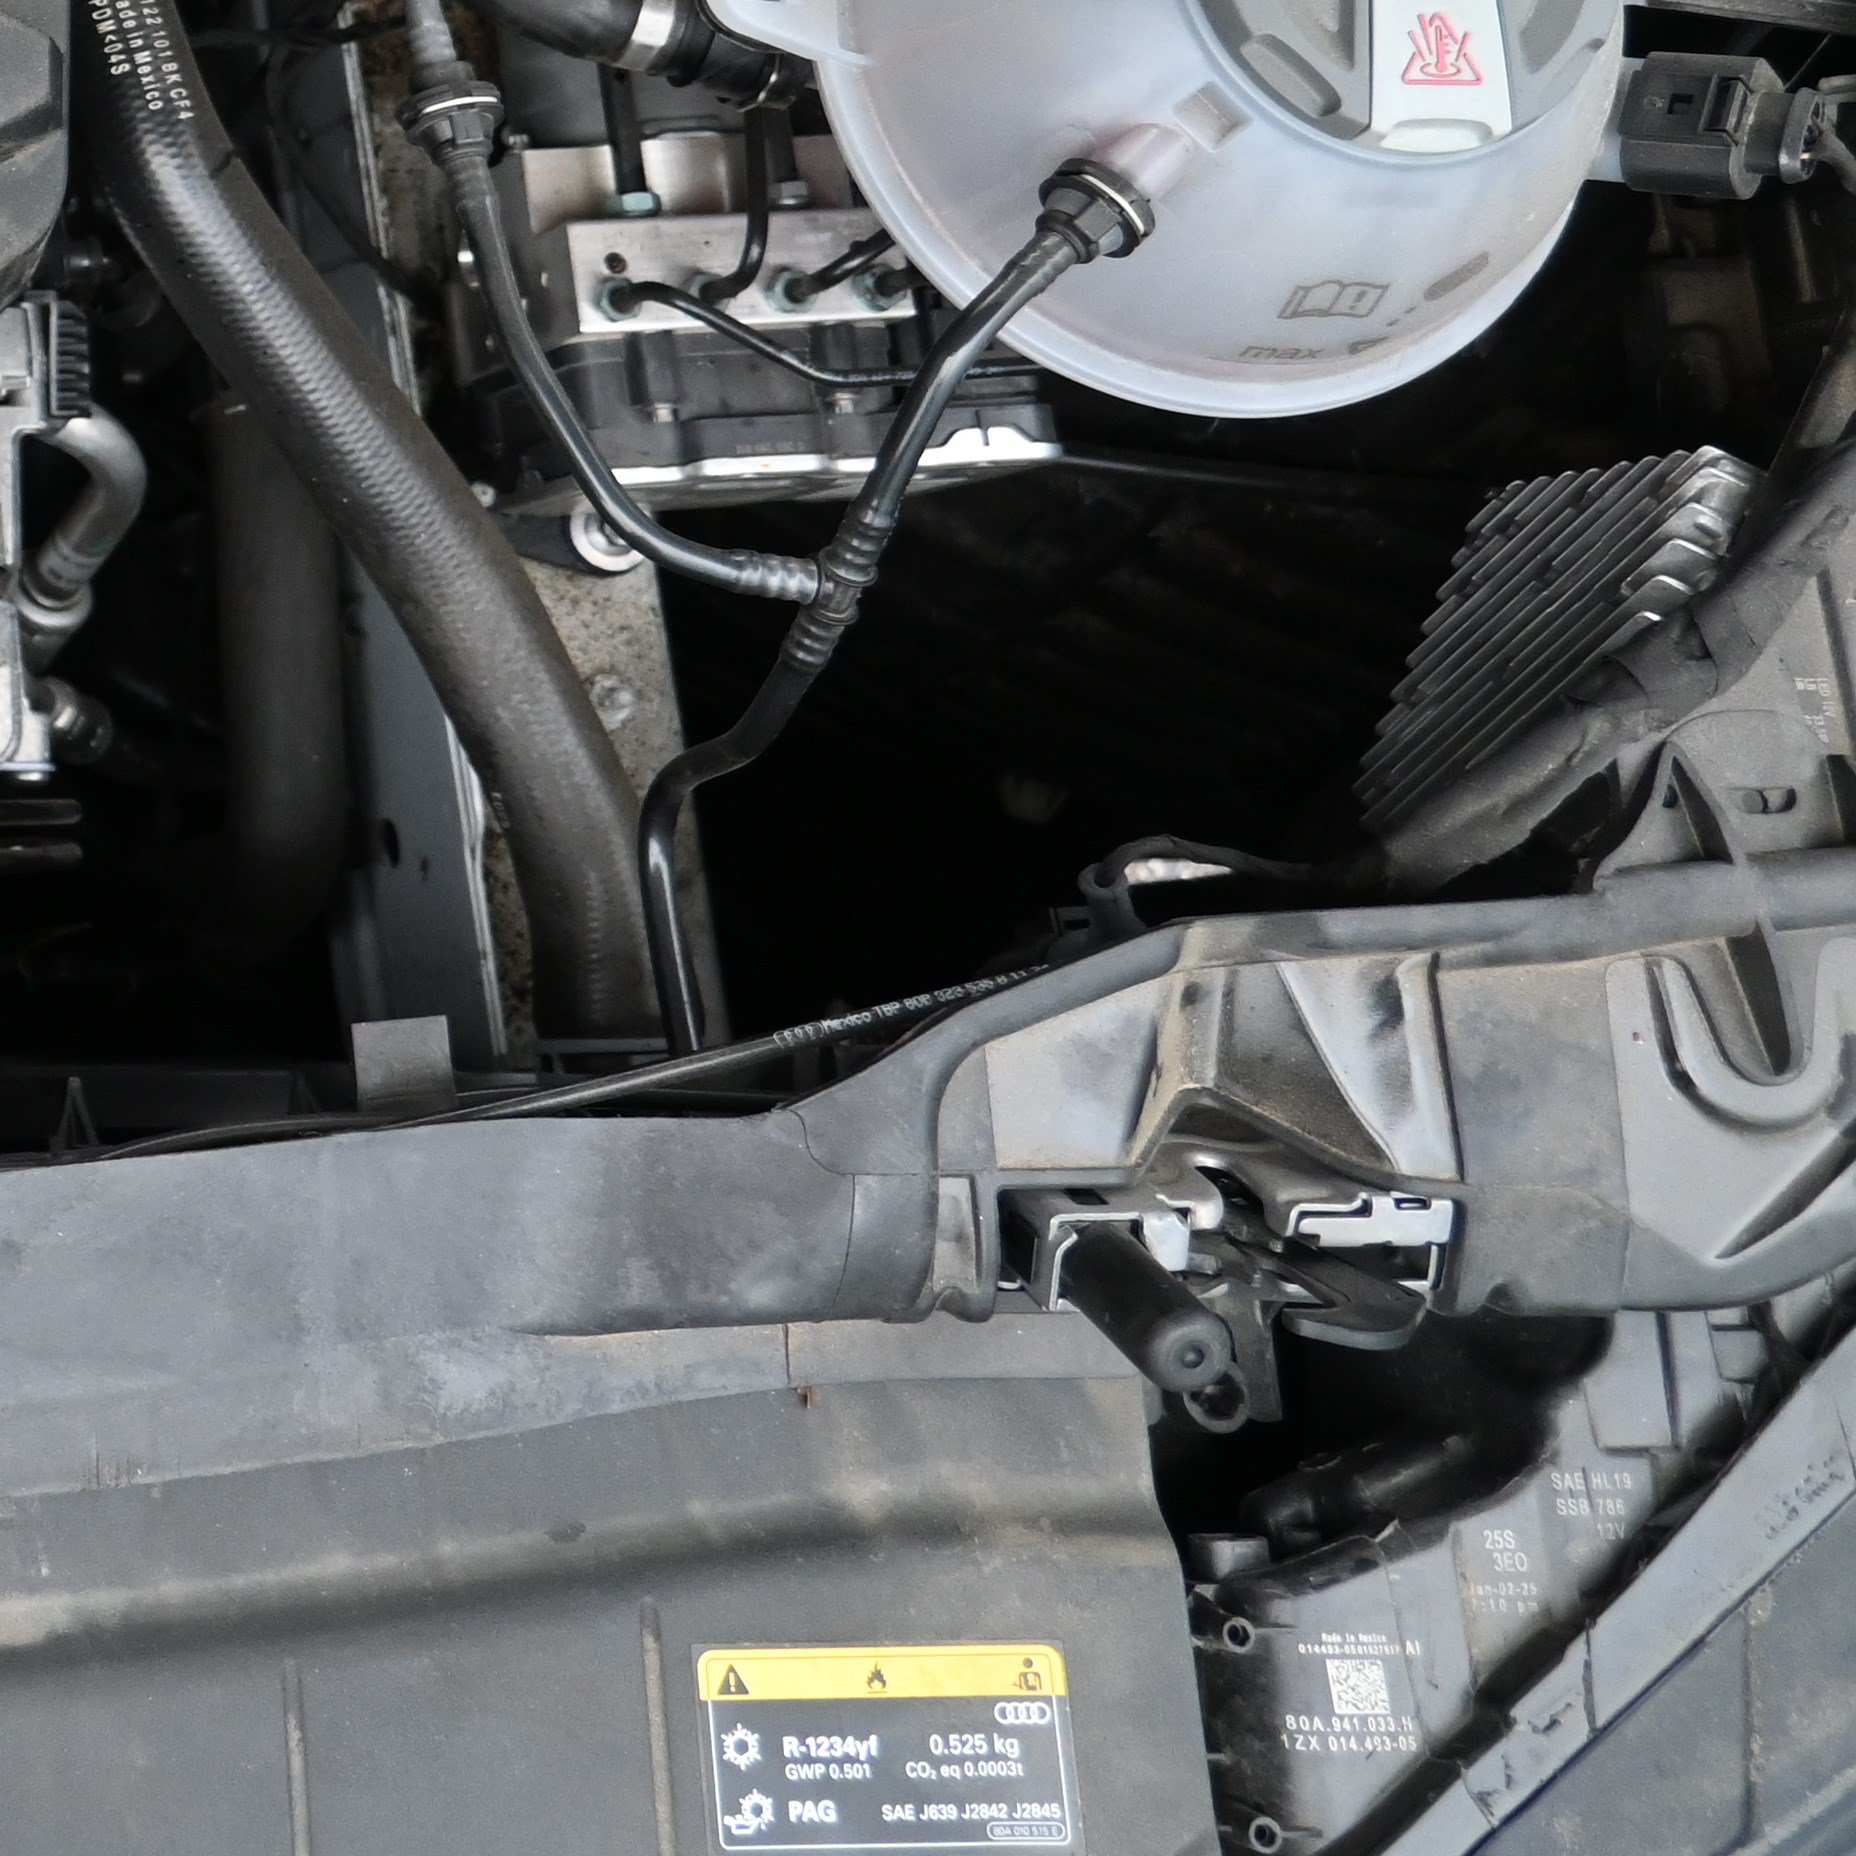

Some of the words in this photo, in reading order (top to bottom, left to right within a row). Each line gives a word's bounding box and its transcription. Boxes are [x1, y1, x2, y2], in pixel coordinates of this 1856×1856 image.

[126, 31, 144, 48] in
[152, 31, 173, 57] 101
[133, 50, 163, 111] Mexico
[1239, 345, 1324, 359] max
[1551, 1472, 1586, 1490] SAE
[1556, 1498, 1590, 1515] SSB
[1596, 1499, 1624, 1515] 786
[1483, 1529, 1516, 1550] 25S
[1597, 1523, 1624, 1540] 12V
[1358, 1633, 1386, 1643] Mexico
[1285, 1714, 1413, 1732] 80A.941.033.H
[782, 1734, 879, 1761] R-1234yf
[929, 1733, 988, 1755] 0.525
[993, 1733, 1020, 1759] kg
[1280, 1733, 1320, 1751] 1ZX
[1328, 1735, 1417, 1752] 014.493-05
[785, 1763, 826, 1781] GWP
[829, 1763, 872, 1779] 0.501
[940, 1764, 961, 1780] eq
[963, 1761, 1024, 1777] 0.0003t
[788, 1799, 837, 1823] PAG
[881, 1803, 916, 1821] SAE
[919, 1804, 958, 1820] J639
[961, 1803, 1008, 1819] J2842
[1012, 1802, 1062, 1819] J2845
